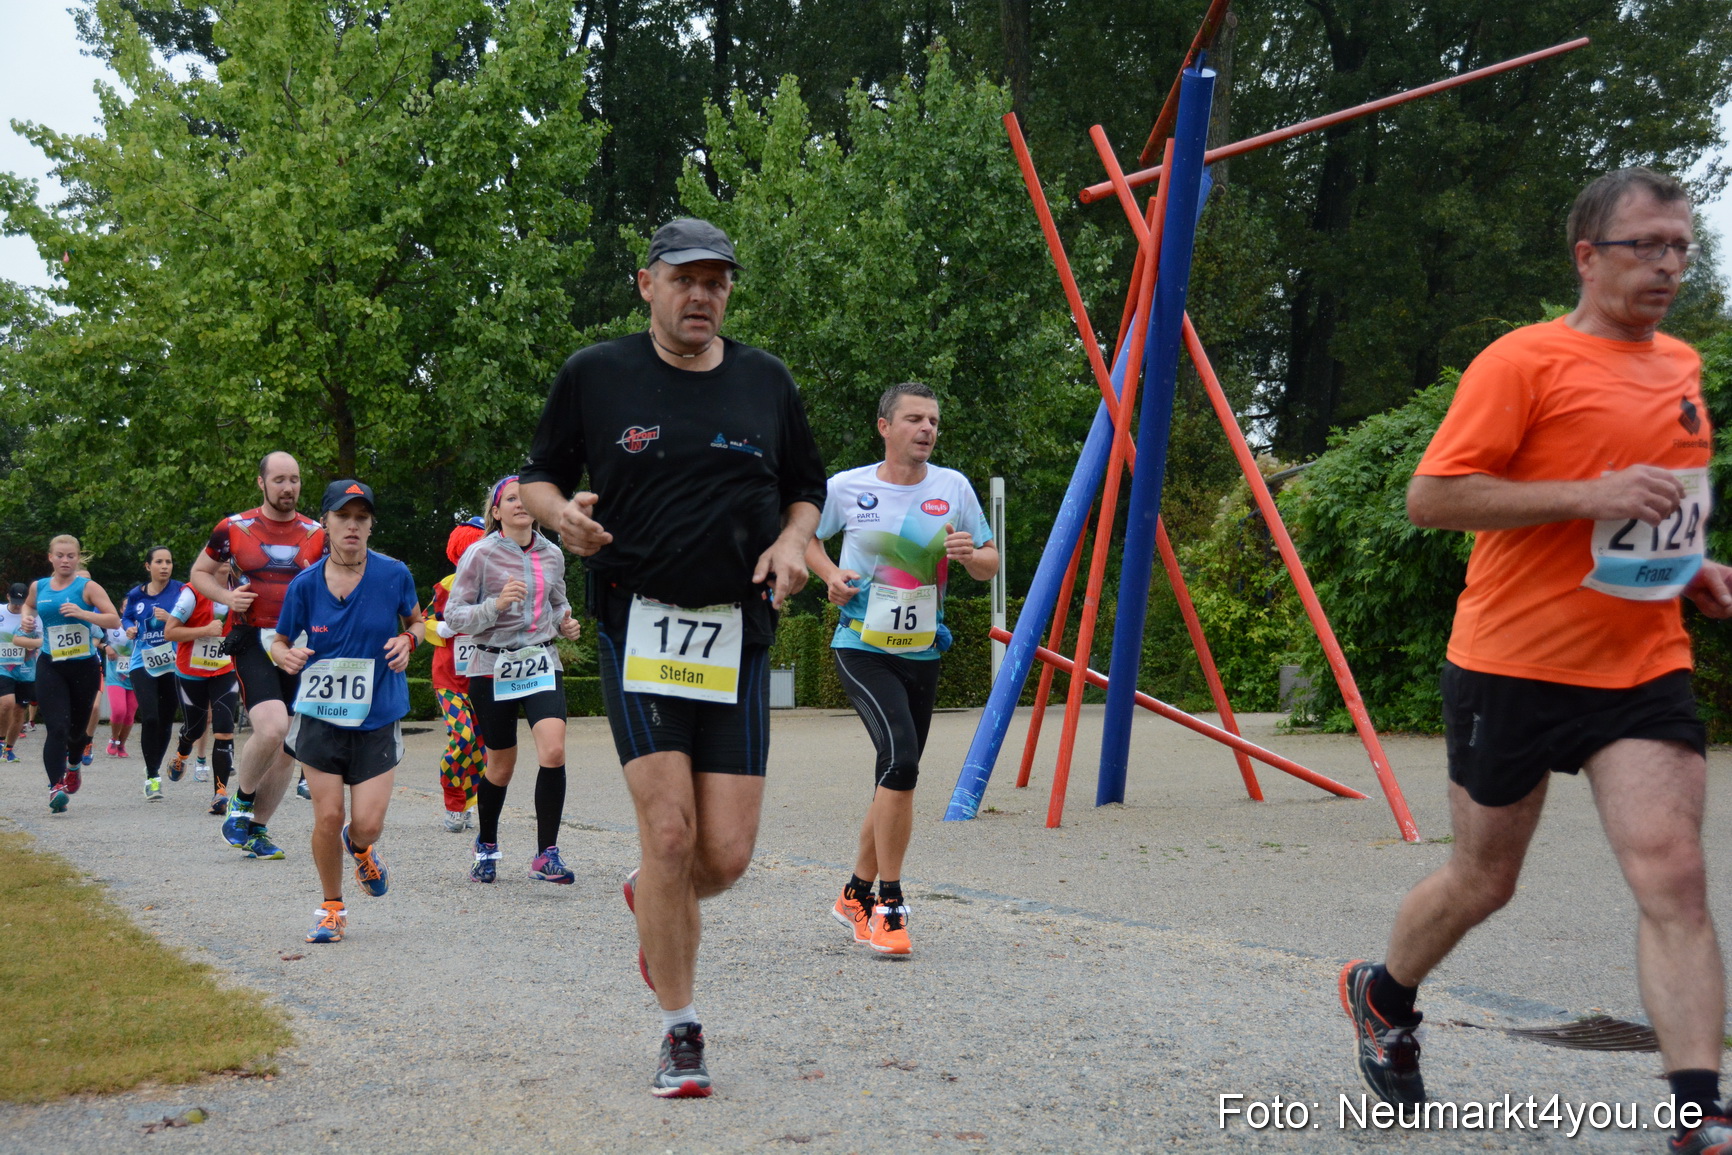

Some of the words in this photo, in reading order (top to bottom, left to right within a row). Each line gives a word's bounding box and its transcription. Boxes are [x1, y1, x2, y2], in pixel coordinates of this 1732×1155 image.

[1635, 565, 1673, 582] Franz
[136, 602, 145, 614] 9
[890, 605, 917, 631] 15
[311, 625, 329, 633] Nick
[654, 616, 722, 658] 177
[57, 632, 82, 648] 256
[886, 636, 913, 645] Franz
[1, 648, 24, 657] 3087
[147, 650, 175, 668] 3037
[500, 655, 549, 679] 2724
[660, 664, 704, 684] Stefan
[305, 674, 367, 700] 2316
[511, 680, 538, 691] Sandra
[317, 706, 348, 716] Nicole
